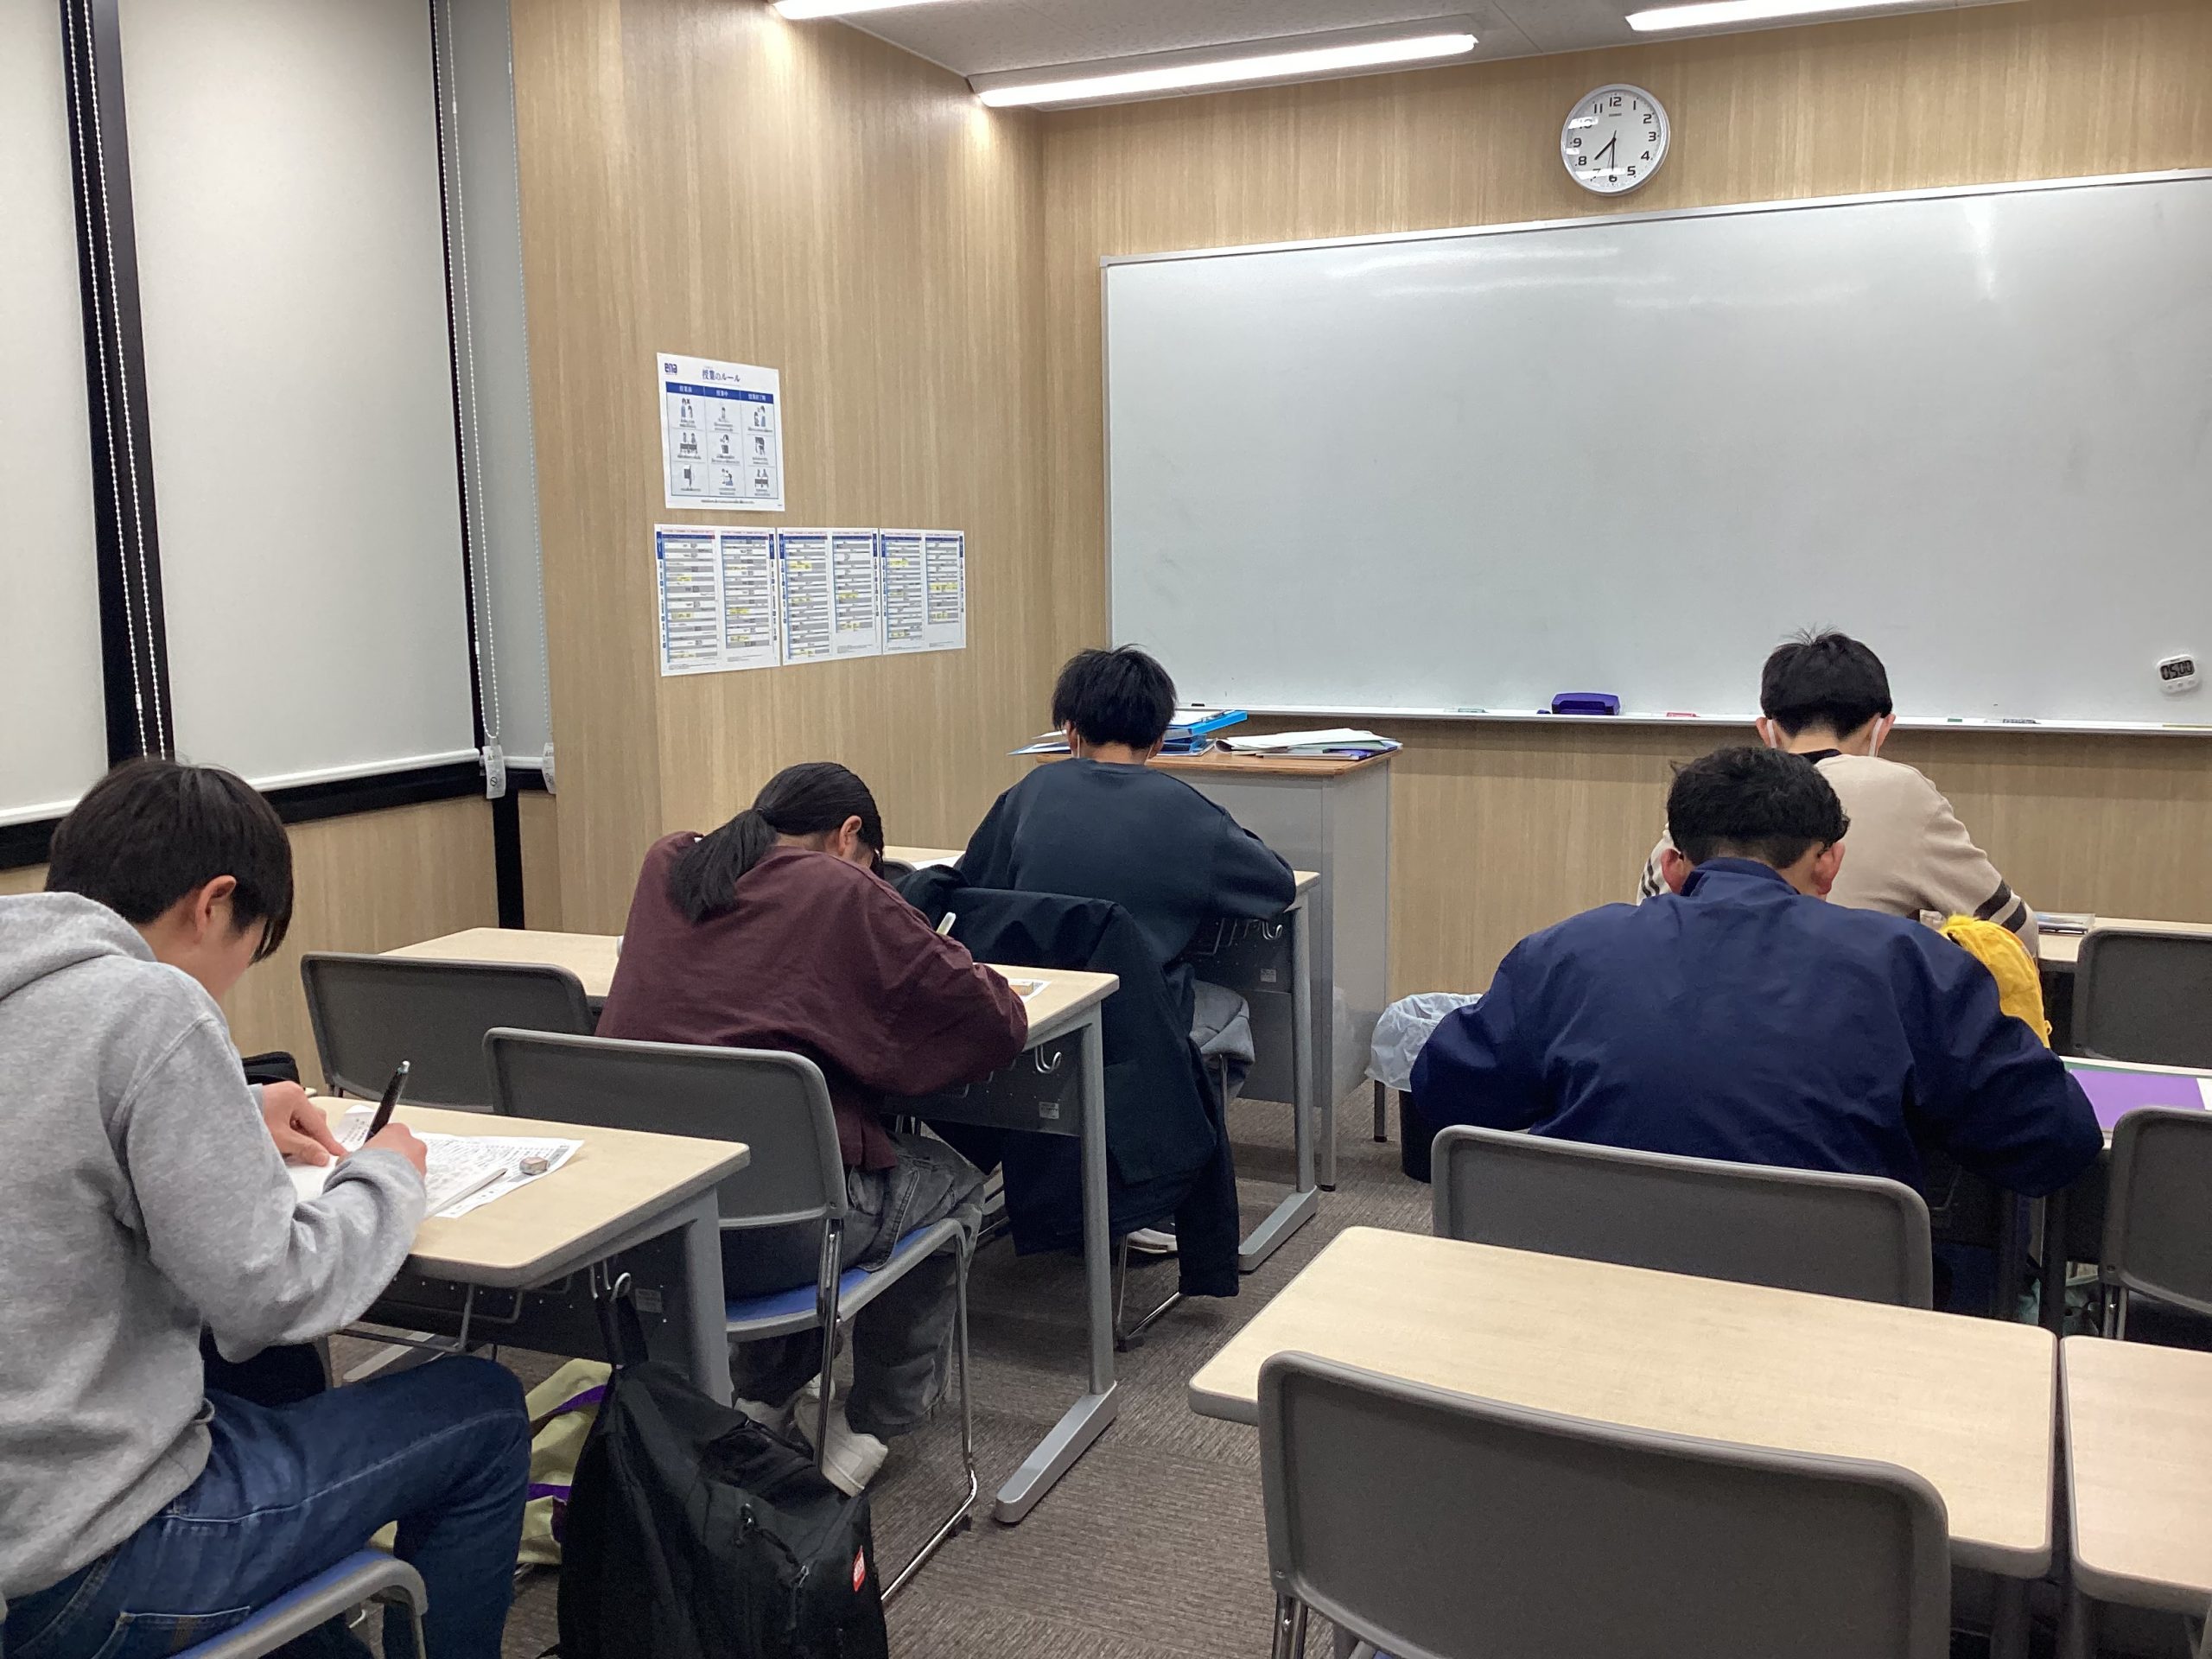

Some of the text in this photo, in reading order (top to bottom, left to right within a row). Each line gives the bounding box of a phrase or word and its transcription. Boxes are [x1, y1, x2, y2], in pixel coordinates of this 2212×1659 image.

[1609, 97, 1622, 107] 12
[1632, 100, 1637, 111] 1
[1593, 104, 1603, 114] 11
[1643, 113, 1652, 124] 2
[1648, 131, 1656, 142] 3
[1573, 137, 1582, 148] 9
[1578, 156, 1587, 166] 8
[1641, 150, 1650, 161] 4
[1627, 165, 1636, 176] 5
[1608, 173, 1618, 182] 6
[702, 369, 741, 382] 授業のルール
